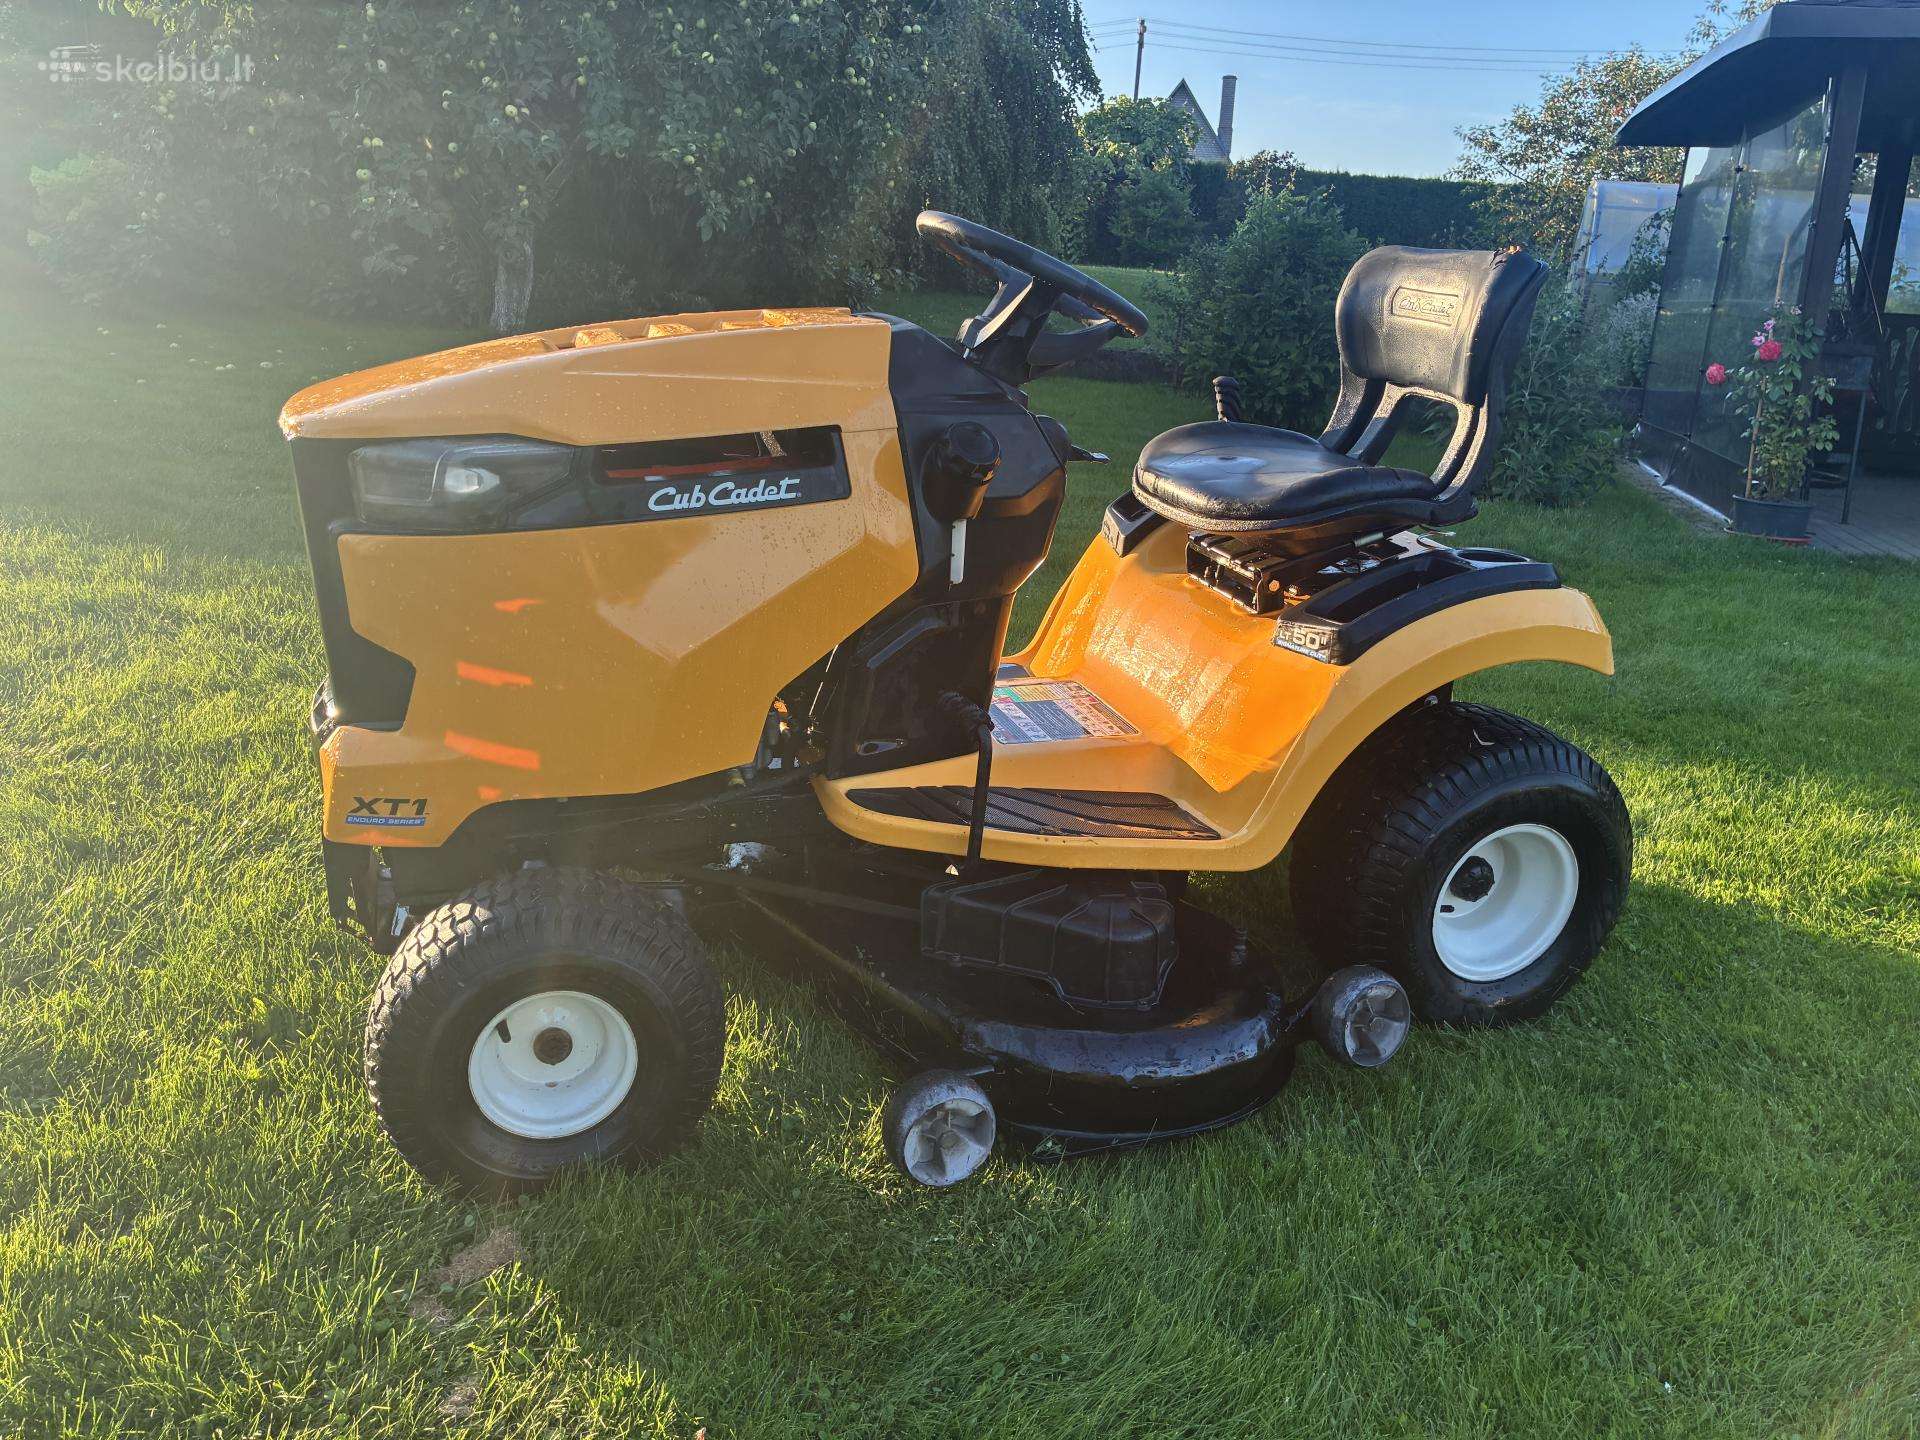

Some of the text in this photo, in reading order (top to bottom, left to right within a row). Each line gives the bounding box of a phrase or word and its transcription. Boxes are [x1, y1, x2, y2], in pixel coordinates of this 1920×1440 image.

[648, 477, 801, 512] Cub Cadet
[347, 796, 428, 815] XT1
[347, 816, 386, 824] ENDURO
